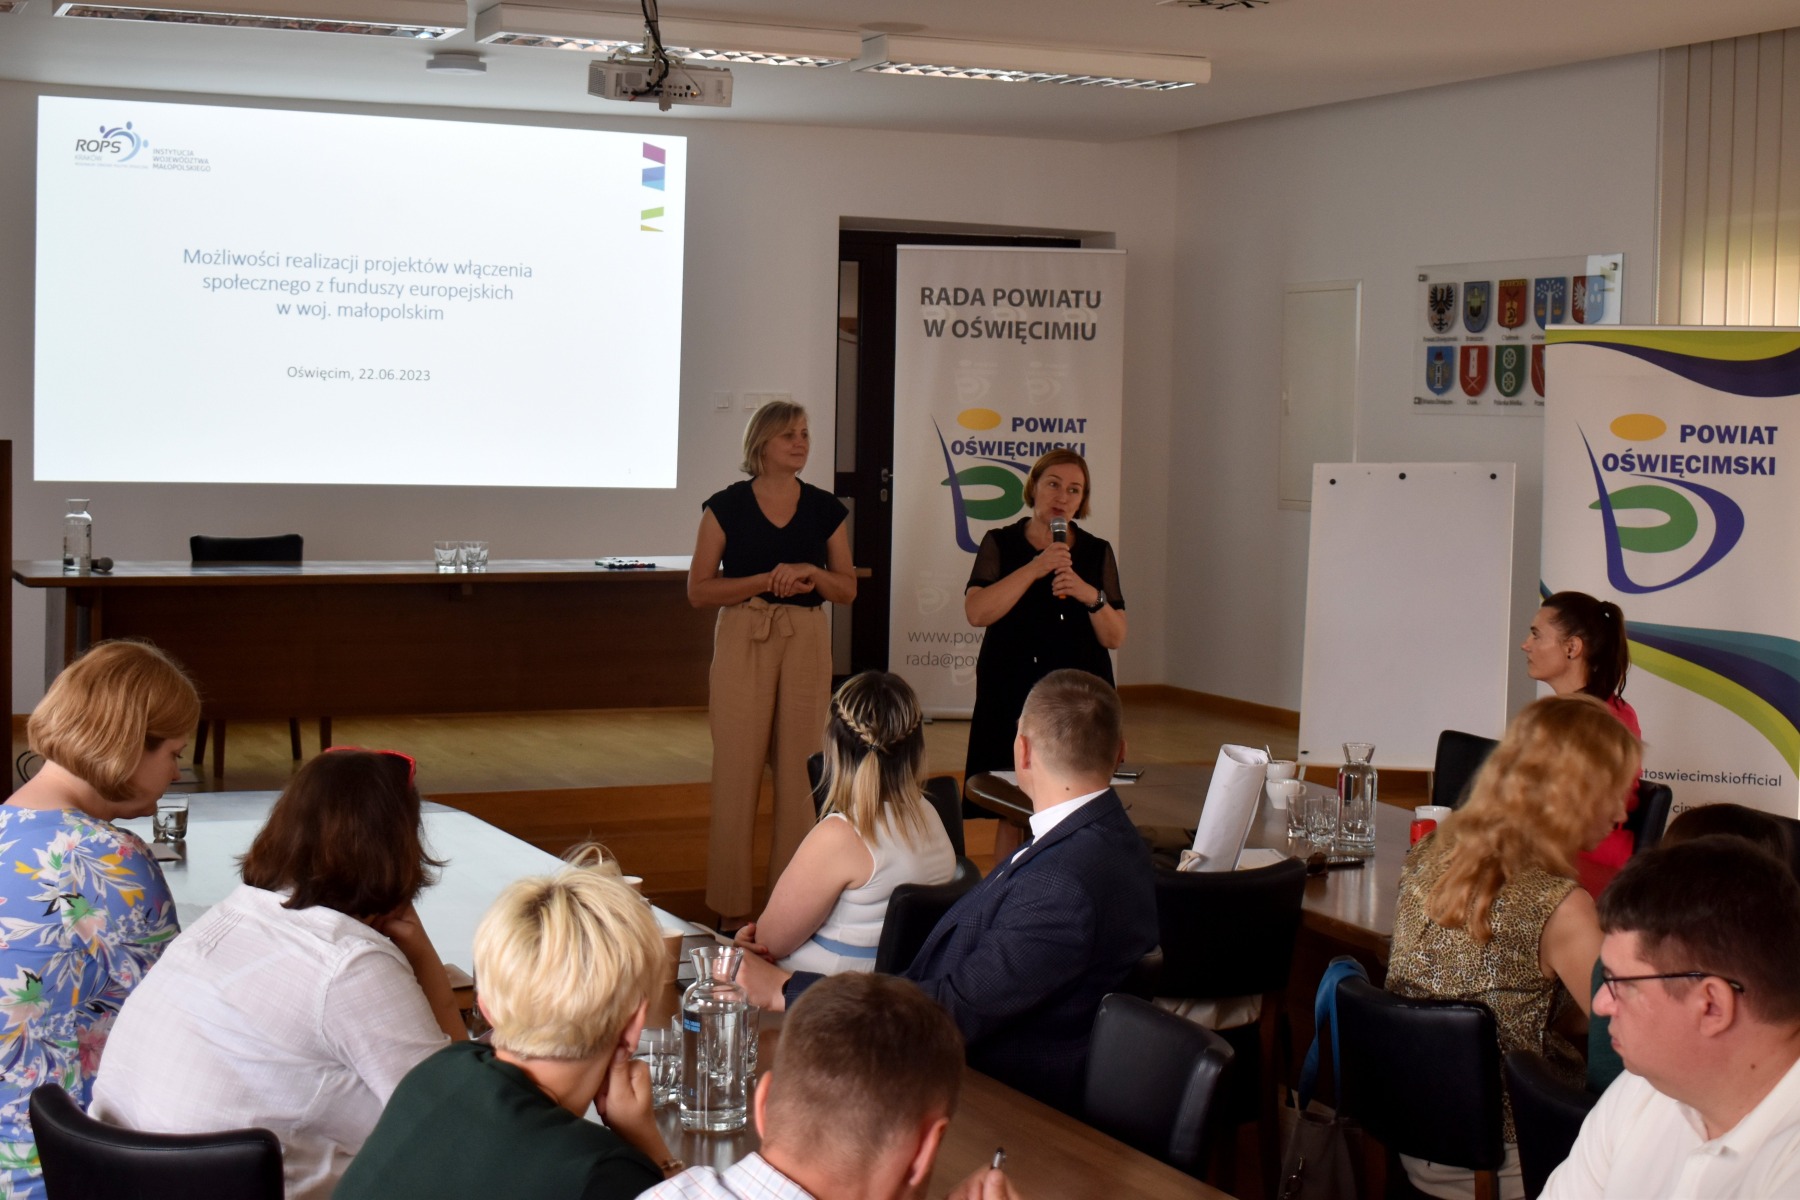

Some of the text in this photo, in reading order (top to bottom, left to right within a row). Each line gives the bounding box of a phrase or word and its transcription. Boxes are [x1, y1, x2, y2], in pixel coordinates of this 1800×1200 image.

[75, 139, 121, 153] ROPS
[153, 148, 194, 156] INSTYTUCJA
[153, 156, 209, 165] WOJEWÓDZTWA
[153, 163, 211, 172] MAŁOPOLSKIEGO
[183, 248, 533, 279] Możliwości realizacji projektów włączenia
[202, 274, 514, 302] społecznego z funduszy europejskich
[920, 286, 1102, 309] RADA POWIATU
[276, 301, 444, 322] w woj. małopolskim
[923, 316, 1097, 345] W OŚWIĘCIMIU
[287, 365, 431, 381] Oświęcim, 22.06.2023
[1011, 417, 1087, 433] POWIAT
[1680, 424, 1778, 445] POWIAT
[1602, 448, 1776, 478] OŚWIĘCIMSKI
[906, 652, 979, 670] rada@po
